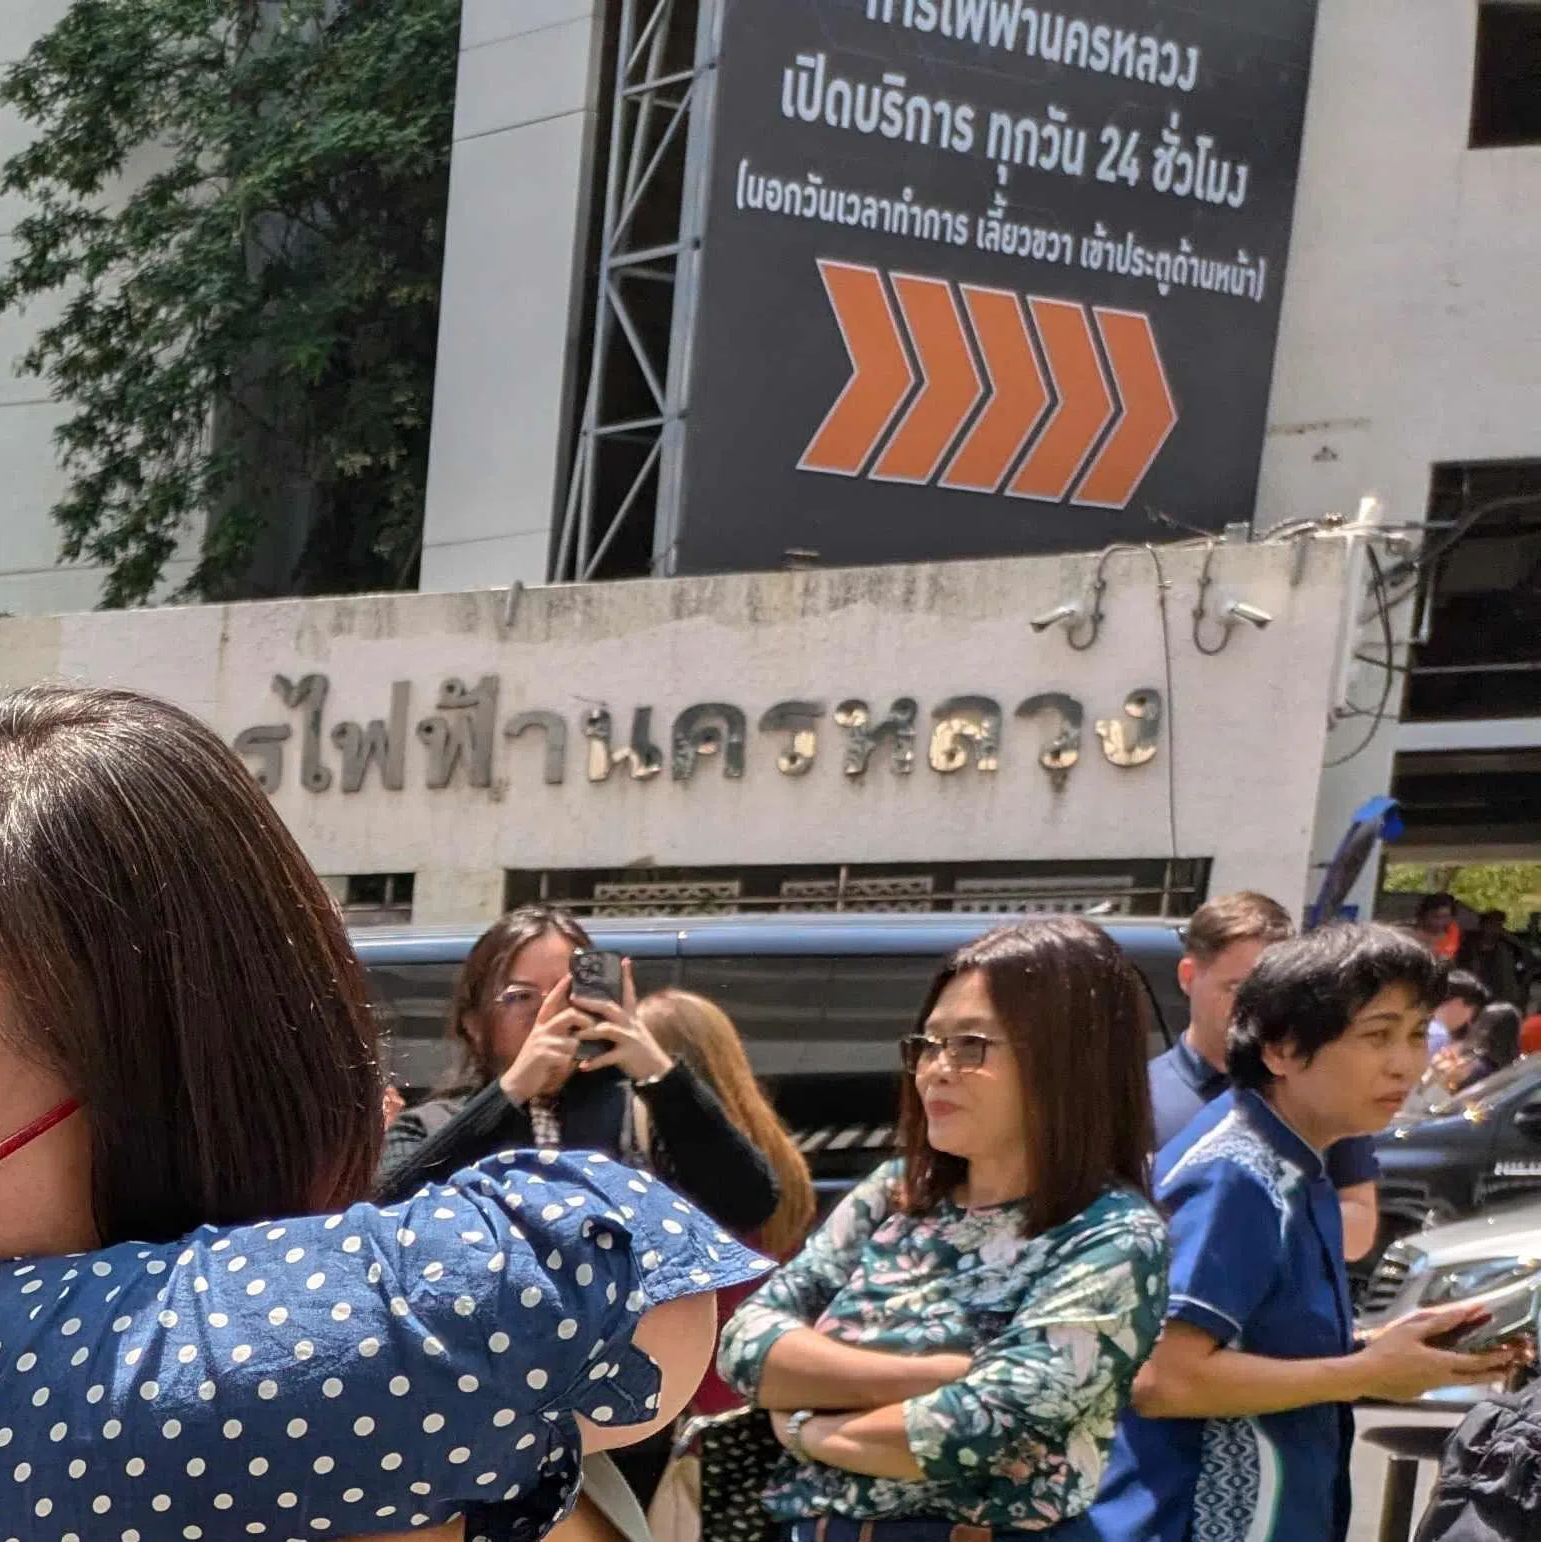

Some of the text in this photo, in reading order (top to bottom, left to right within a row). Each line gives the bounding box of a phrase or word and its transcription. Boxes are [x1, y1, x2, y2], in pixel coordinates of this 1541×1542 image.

[781, 52, 1251, 208] เปิดบริการ ทุกวัน 24 ชั่วโมง
[976, 191, 1073, 265] เลี้ยวขวา
[232, 673, 1163, 796] รไฟฟ้านครหลวง
